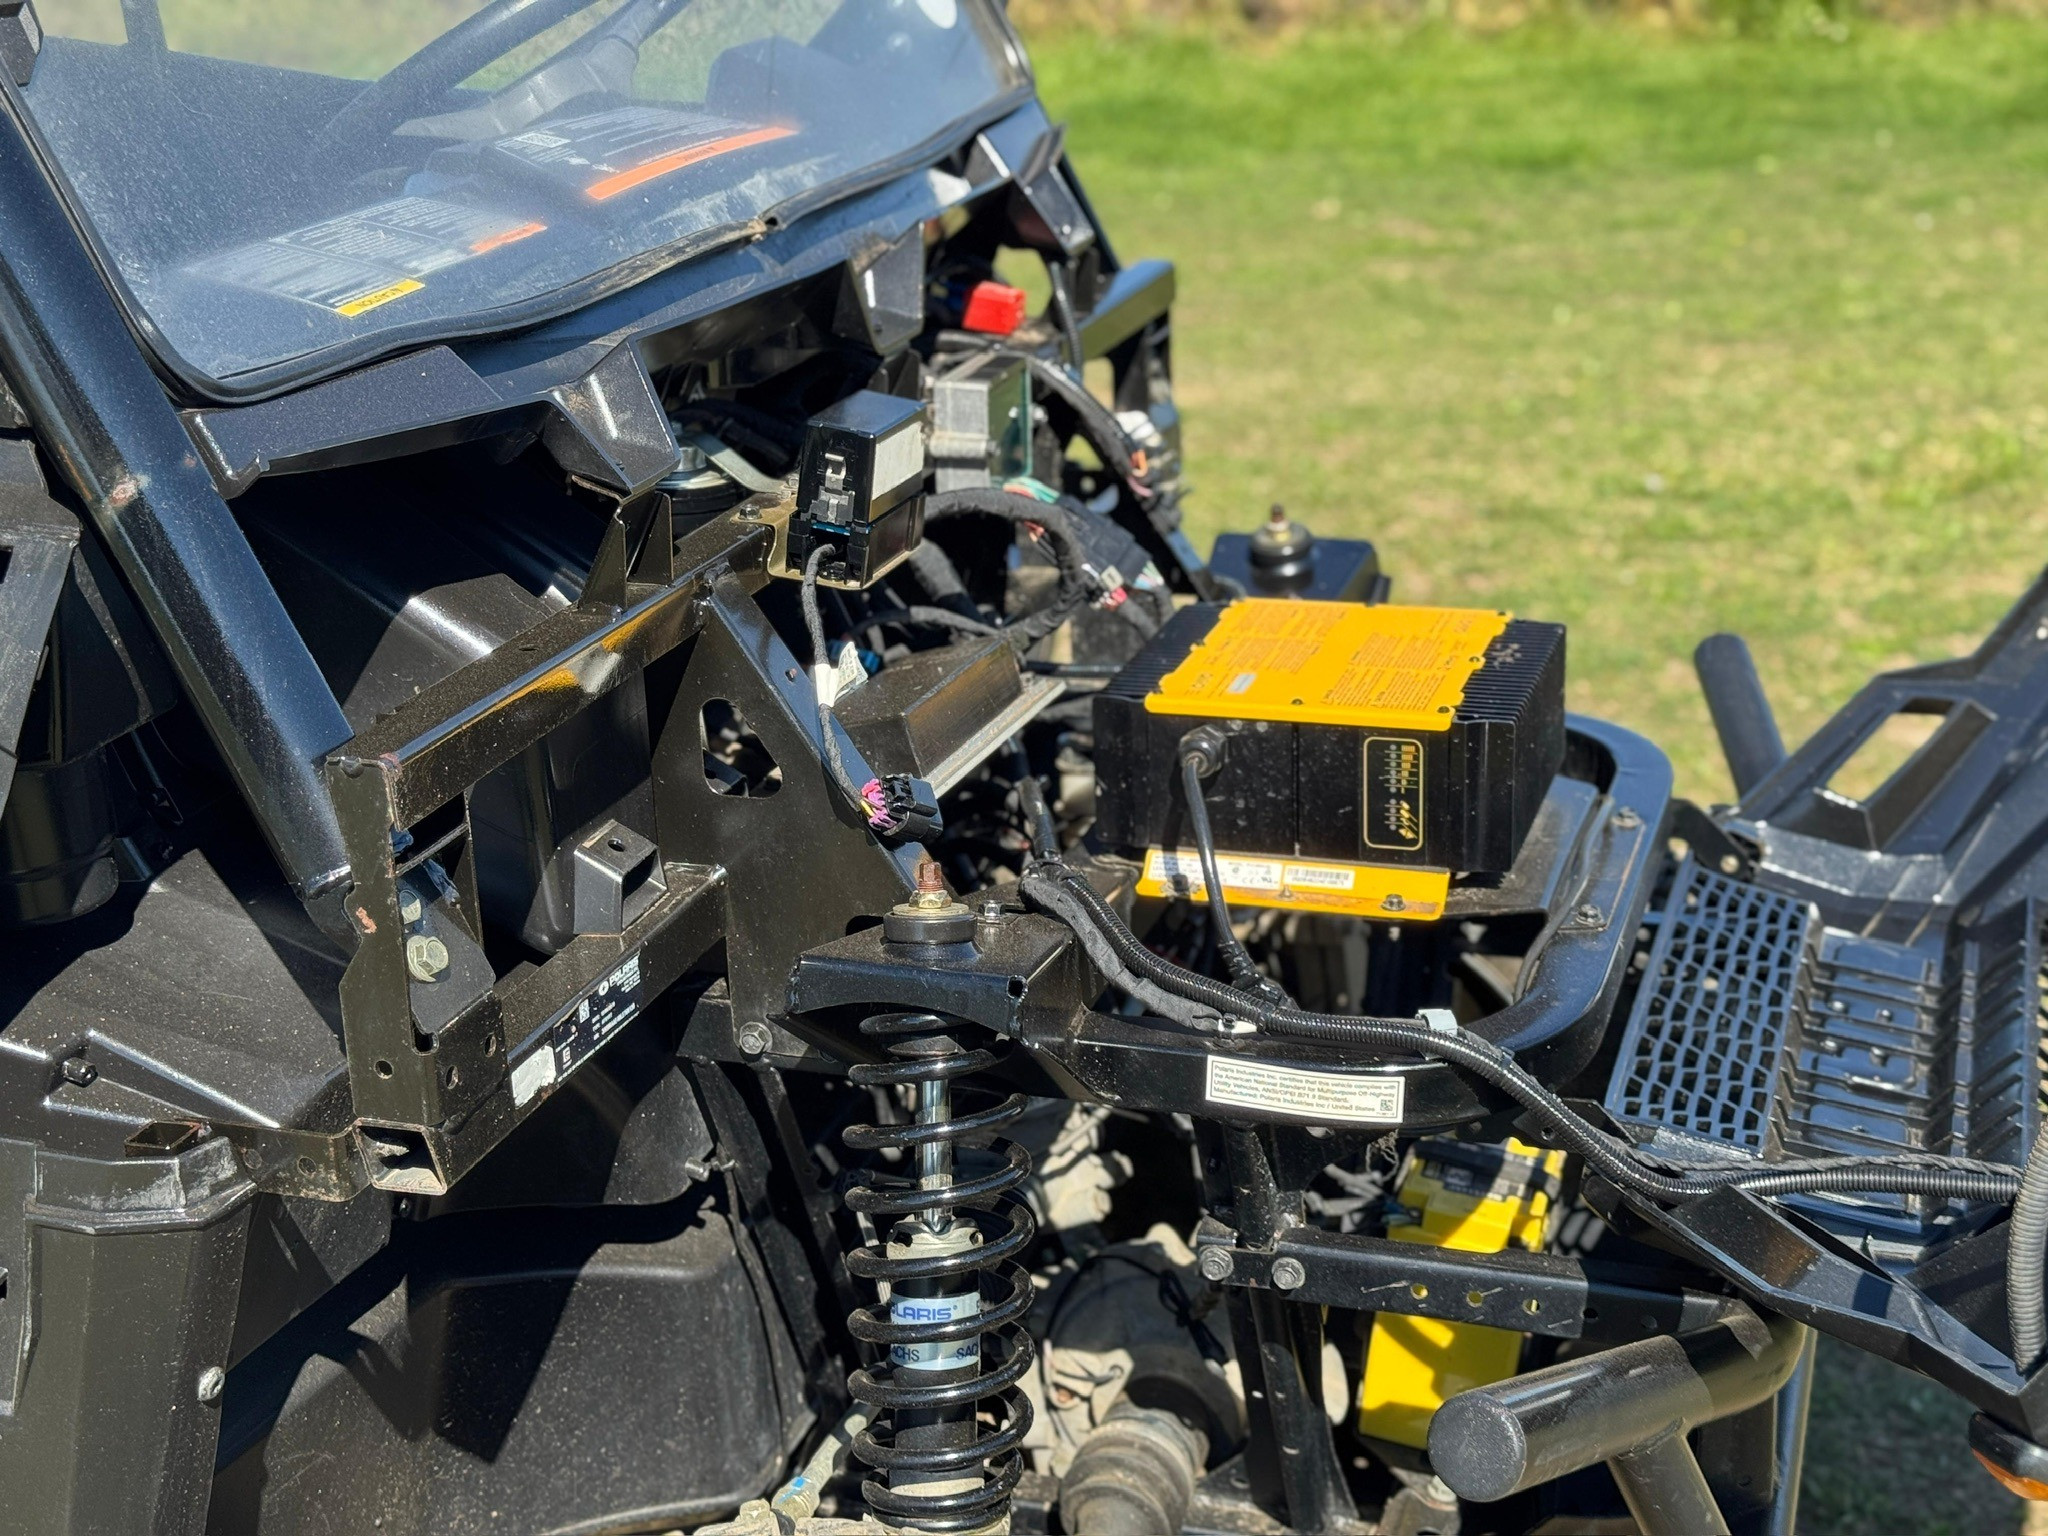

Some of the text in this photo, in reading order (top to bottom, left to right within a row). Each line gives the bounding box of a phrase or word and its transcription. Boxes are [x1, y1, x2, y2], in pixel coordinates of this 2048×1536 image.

[1214, 1064, 1234, 1073] Polaris
[1236, 1069, 1265, 1078] Industries
[1213, 1079, 1231, 1088] Utility
[1224, 1074, 1252, 1083] American
[1253, 1078, 1278, 1087] National
[1279, 1082, 1306, 1091] Standard
[1317, 1087, 1357, 1096] Multipurpose
[1259, 1093, 1281, 1102] Polaris
[1282, 1097, 1314, 1107] Industries
